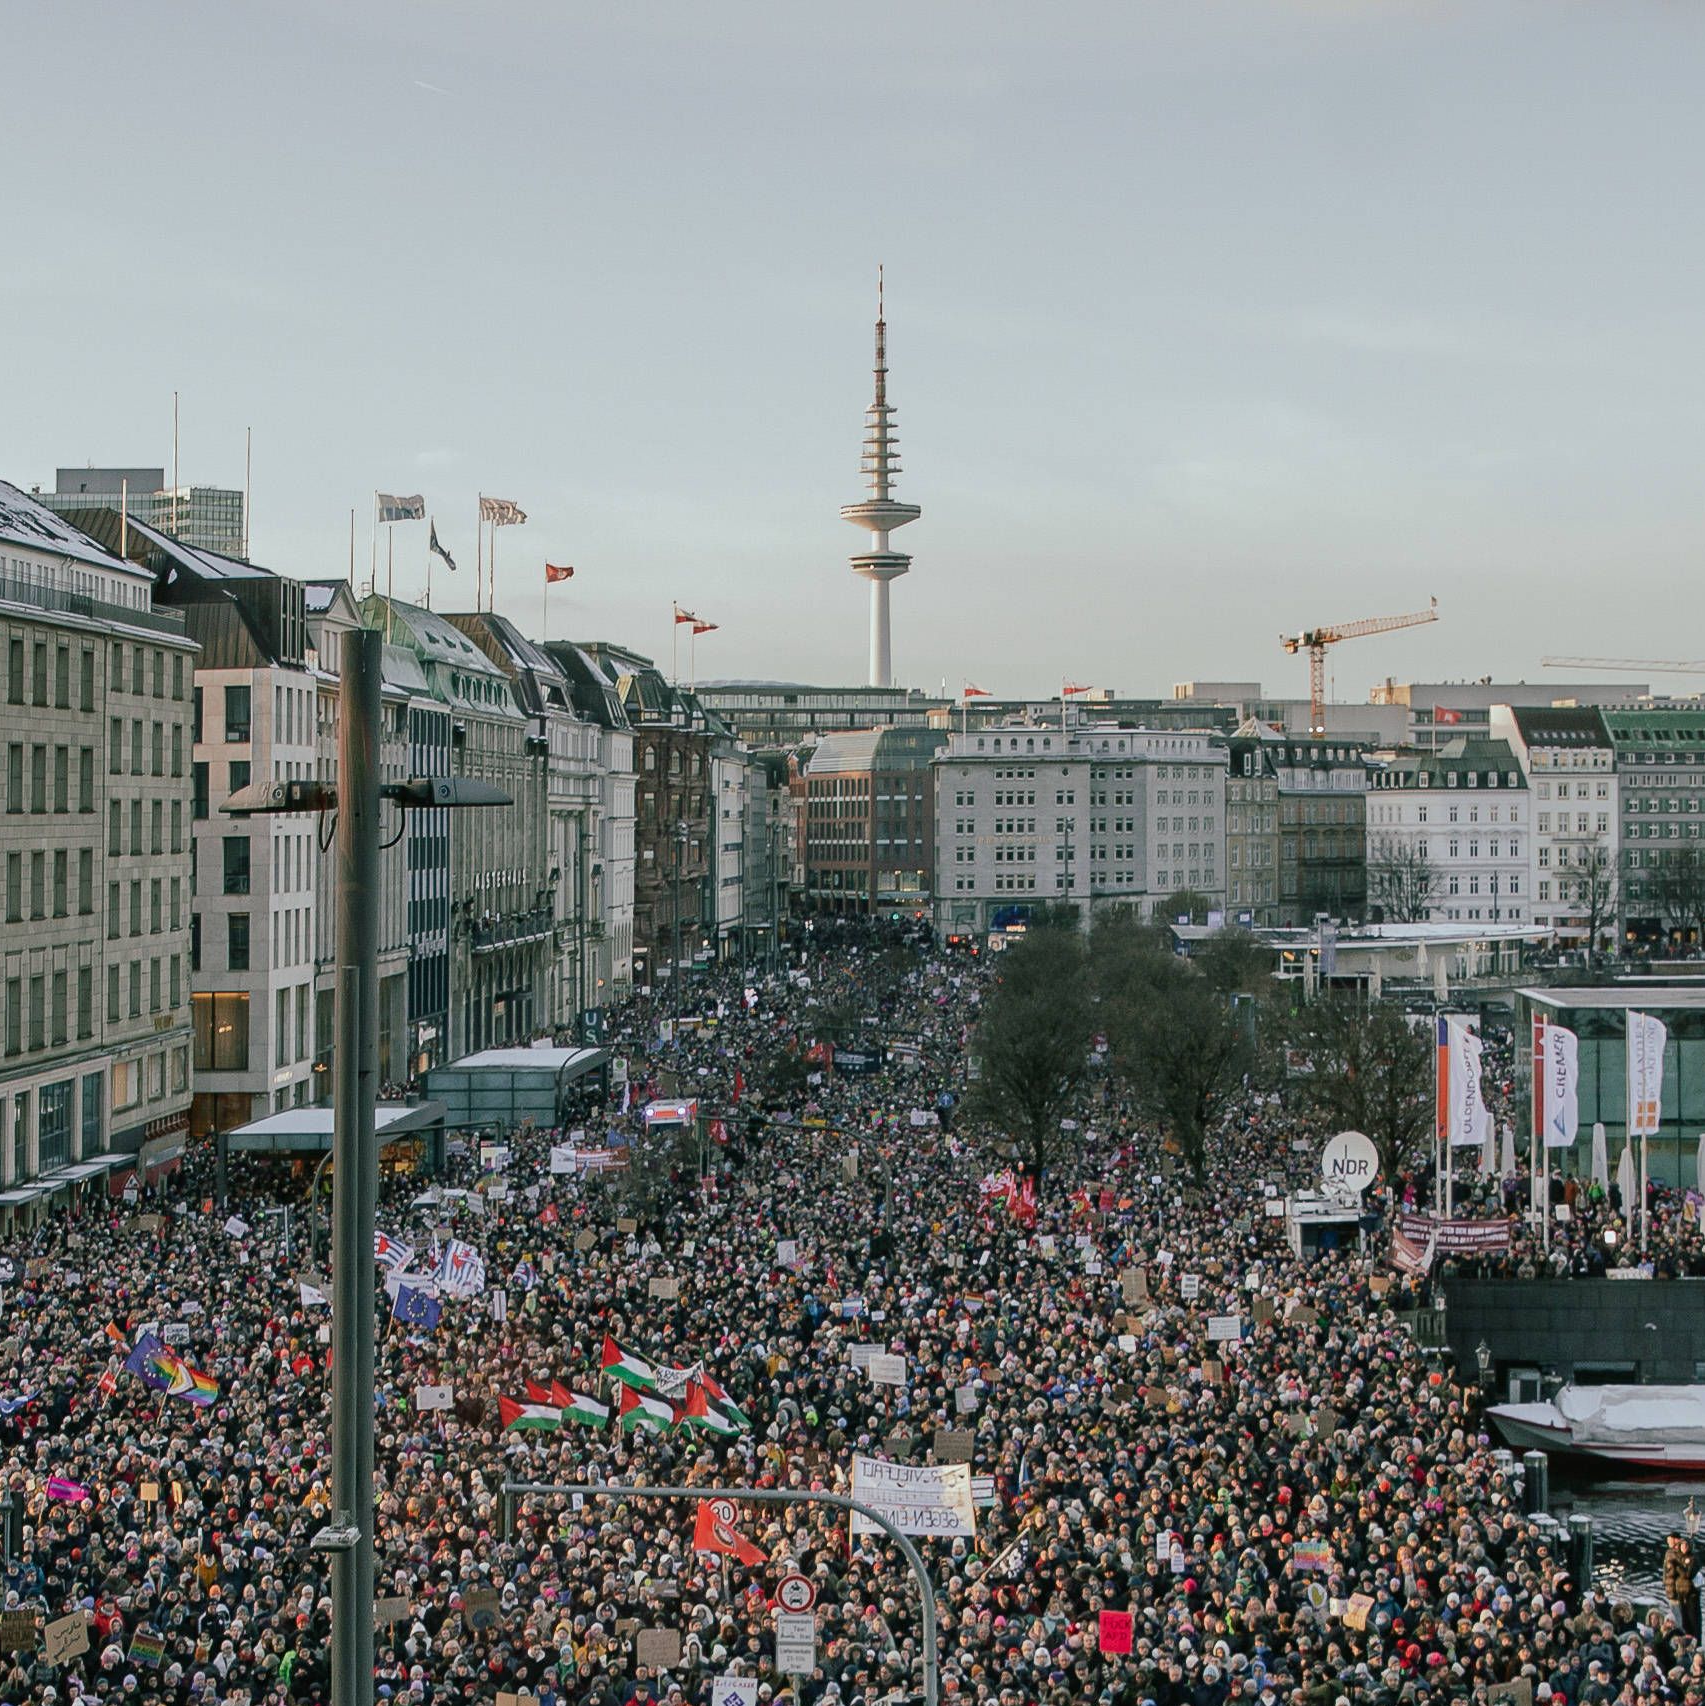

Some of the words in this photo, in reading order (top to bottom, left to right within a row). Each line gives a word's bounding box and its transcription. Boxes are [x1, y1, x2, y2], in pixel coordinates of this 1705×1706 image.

[585, 1012, 597, 1025] U
[585, 1029, 598, 1043] S
[1556, 1033, 1565, 1098] CREMER
[1332, 1158, 1369, 1175] NDR
[712, 1506, 731, 1520] 30
